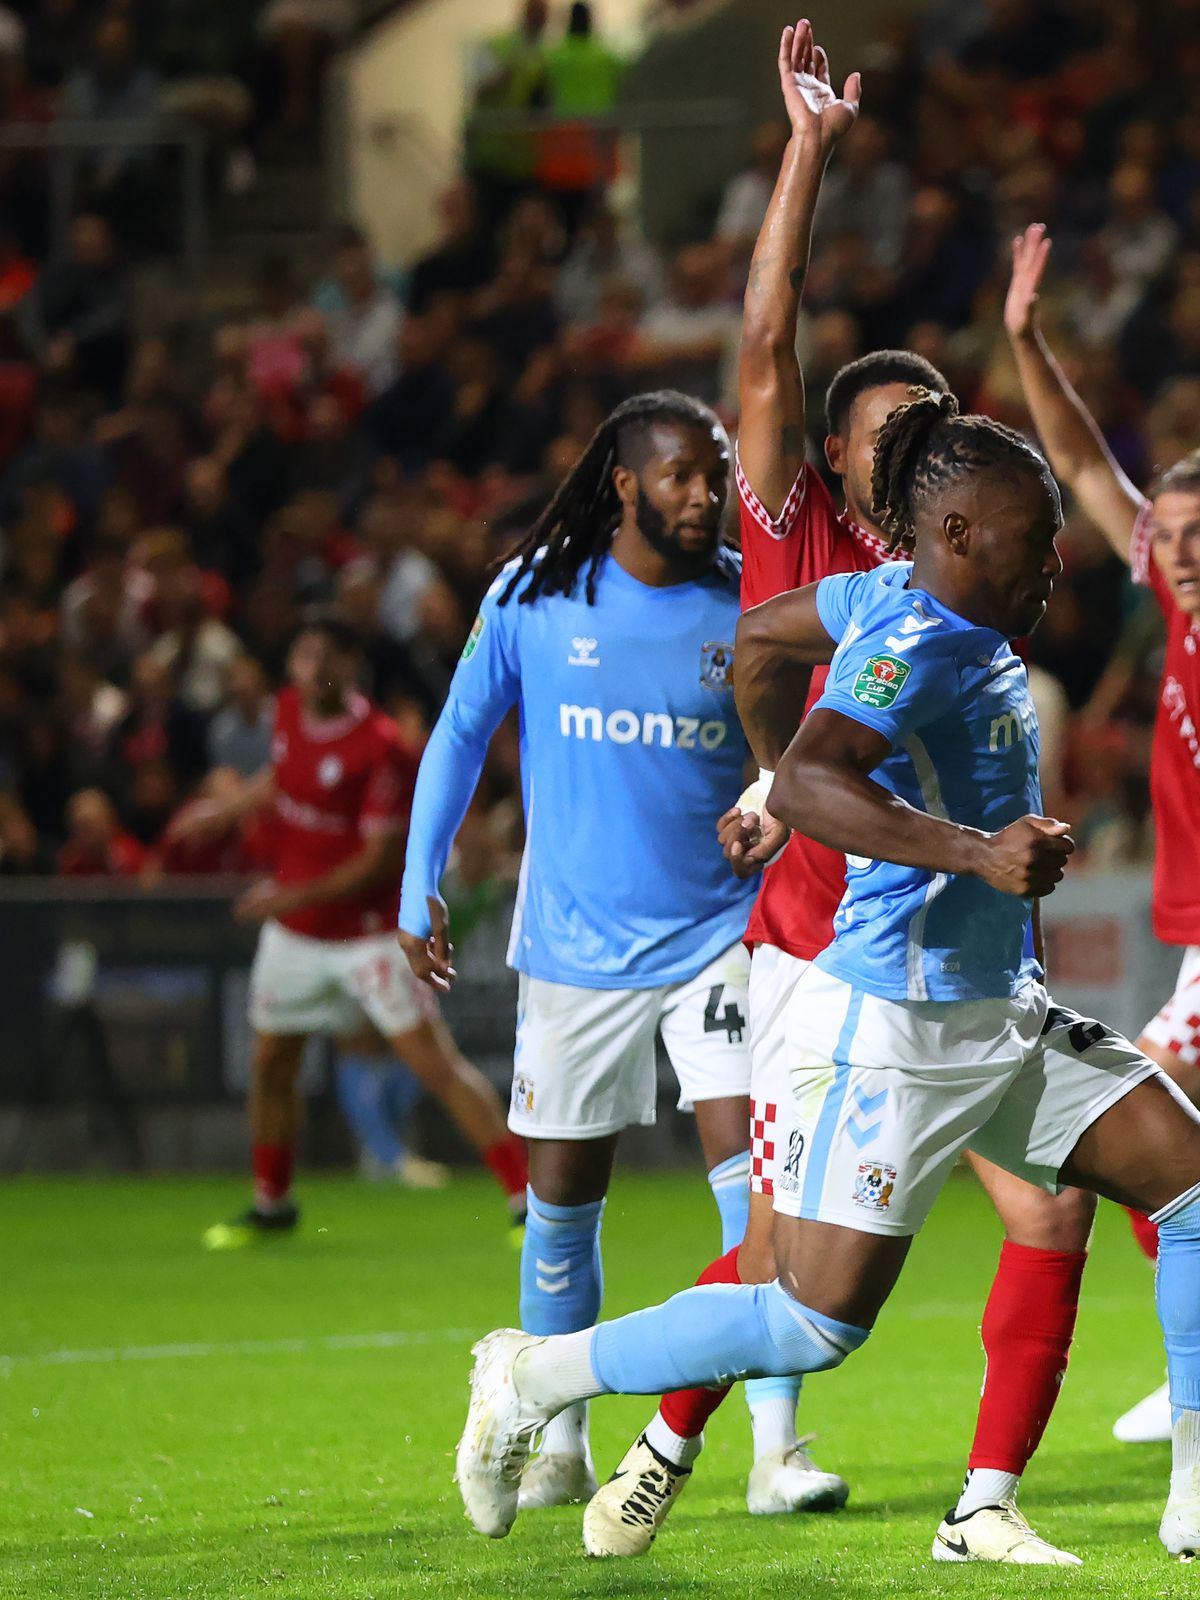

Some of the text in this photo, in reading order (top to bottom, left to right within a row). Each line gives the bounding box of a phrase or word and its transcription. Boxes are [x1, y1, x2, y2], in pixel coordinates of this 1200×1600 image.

[860, 674, 898, 690] Carabao
[866, 682, 885, 693] Cup
[560, 703, 727, 750] monzo
[704, 984, 746, 1044] 4
